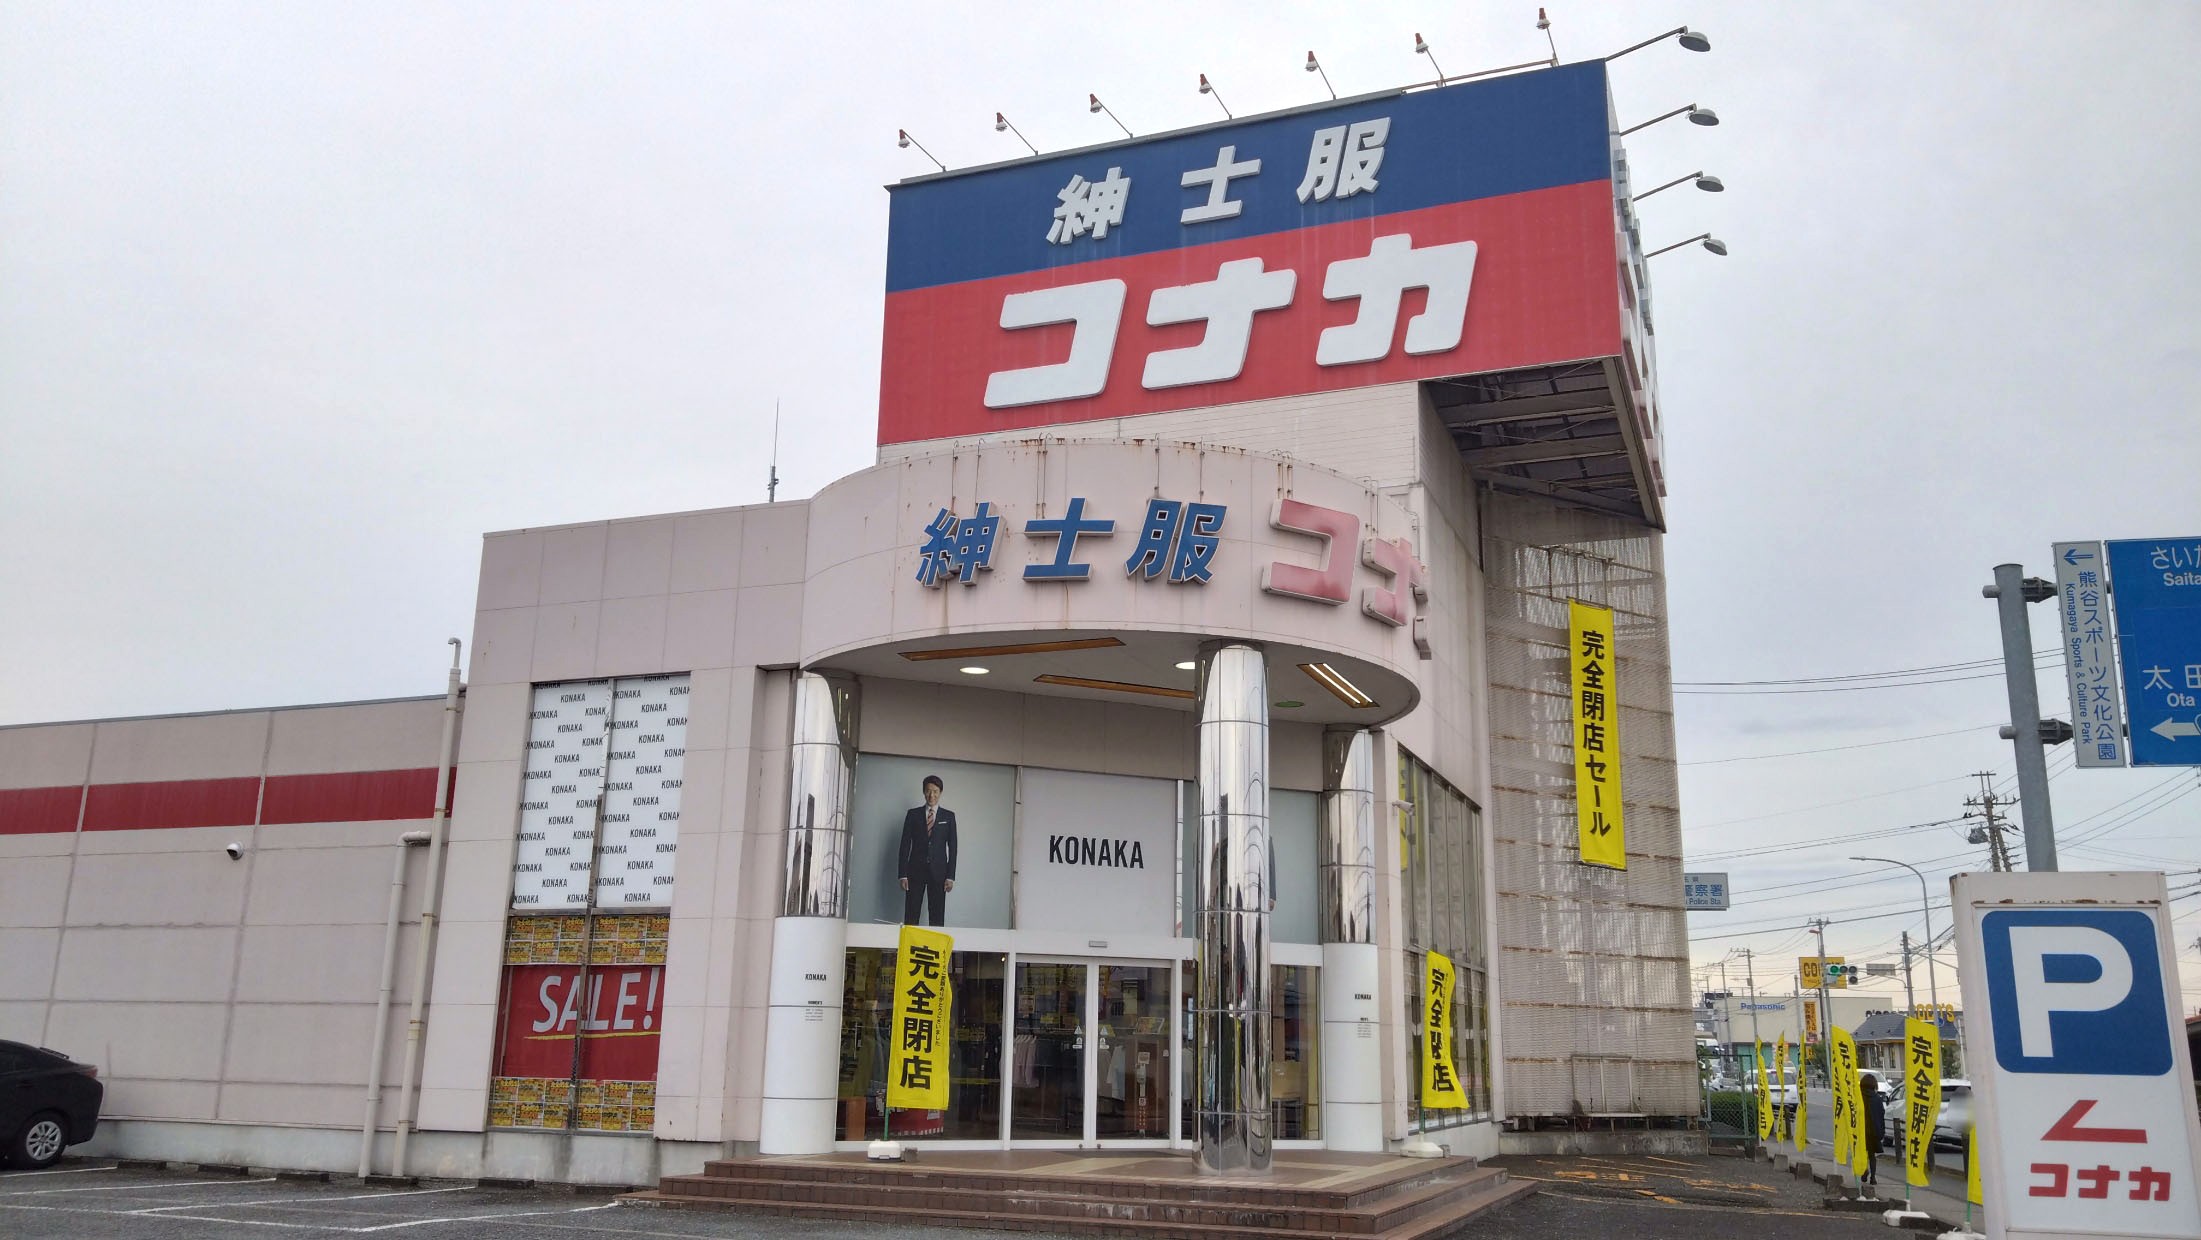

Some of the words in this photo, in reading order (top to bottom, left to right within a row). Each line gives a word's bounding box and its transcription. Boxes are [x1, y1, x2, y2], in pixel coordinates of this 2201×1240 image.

[1045, 117, 1391, 245] 紳士服
[984, 233, 1478, 408] コナカ
[915, 497, 1228, 590] 紳士服
[2065, 583, 2079, 633] Kumagaya
[2072, 637, 2084, 668] Sports
[2079, 571, 2117, 760] 熊谷スポーツ文化公園
[561, 693, 585, 703] KONAKA
[2076, 682, 2088, 718] Culture
[2166, 692, 2196, 707] Ota
[641, 704, 667, 712] KONAKA
[558, 723, 582, 733] KONAKA
[1581, 629, 1612, 837] 完全閉店セール
[2080, 722, 2092, 745] Park
[639, 734, 664, 743] KONAKA
[555, 754, 579, 763] KONAKA
[636, 765, 661, 774] KONAKA
[552, 785, 576, 794] KONAKA
[633, 796, 659, 806] KONAKA
[548, 816, 573, 824] KONAKA
[630, 828, 656, 838] KONAKA
[545, 847, 570, 856] KONAKA
[1049, 835, 1144, 869] KONAKA
[627, 861, 653, 870] KONAKA
[542, 878, 567, 888] KONAKA
[624, 893, 650, 902] KONAKA
[2009, 926, 2133, 1057] P
[900, 945, 940, 1090] 完全閉店
[2029, 1163, 2171, 1202] コナカ
